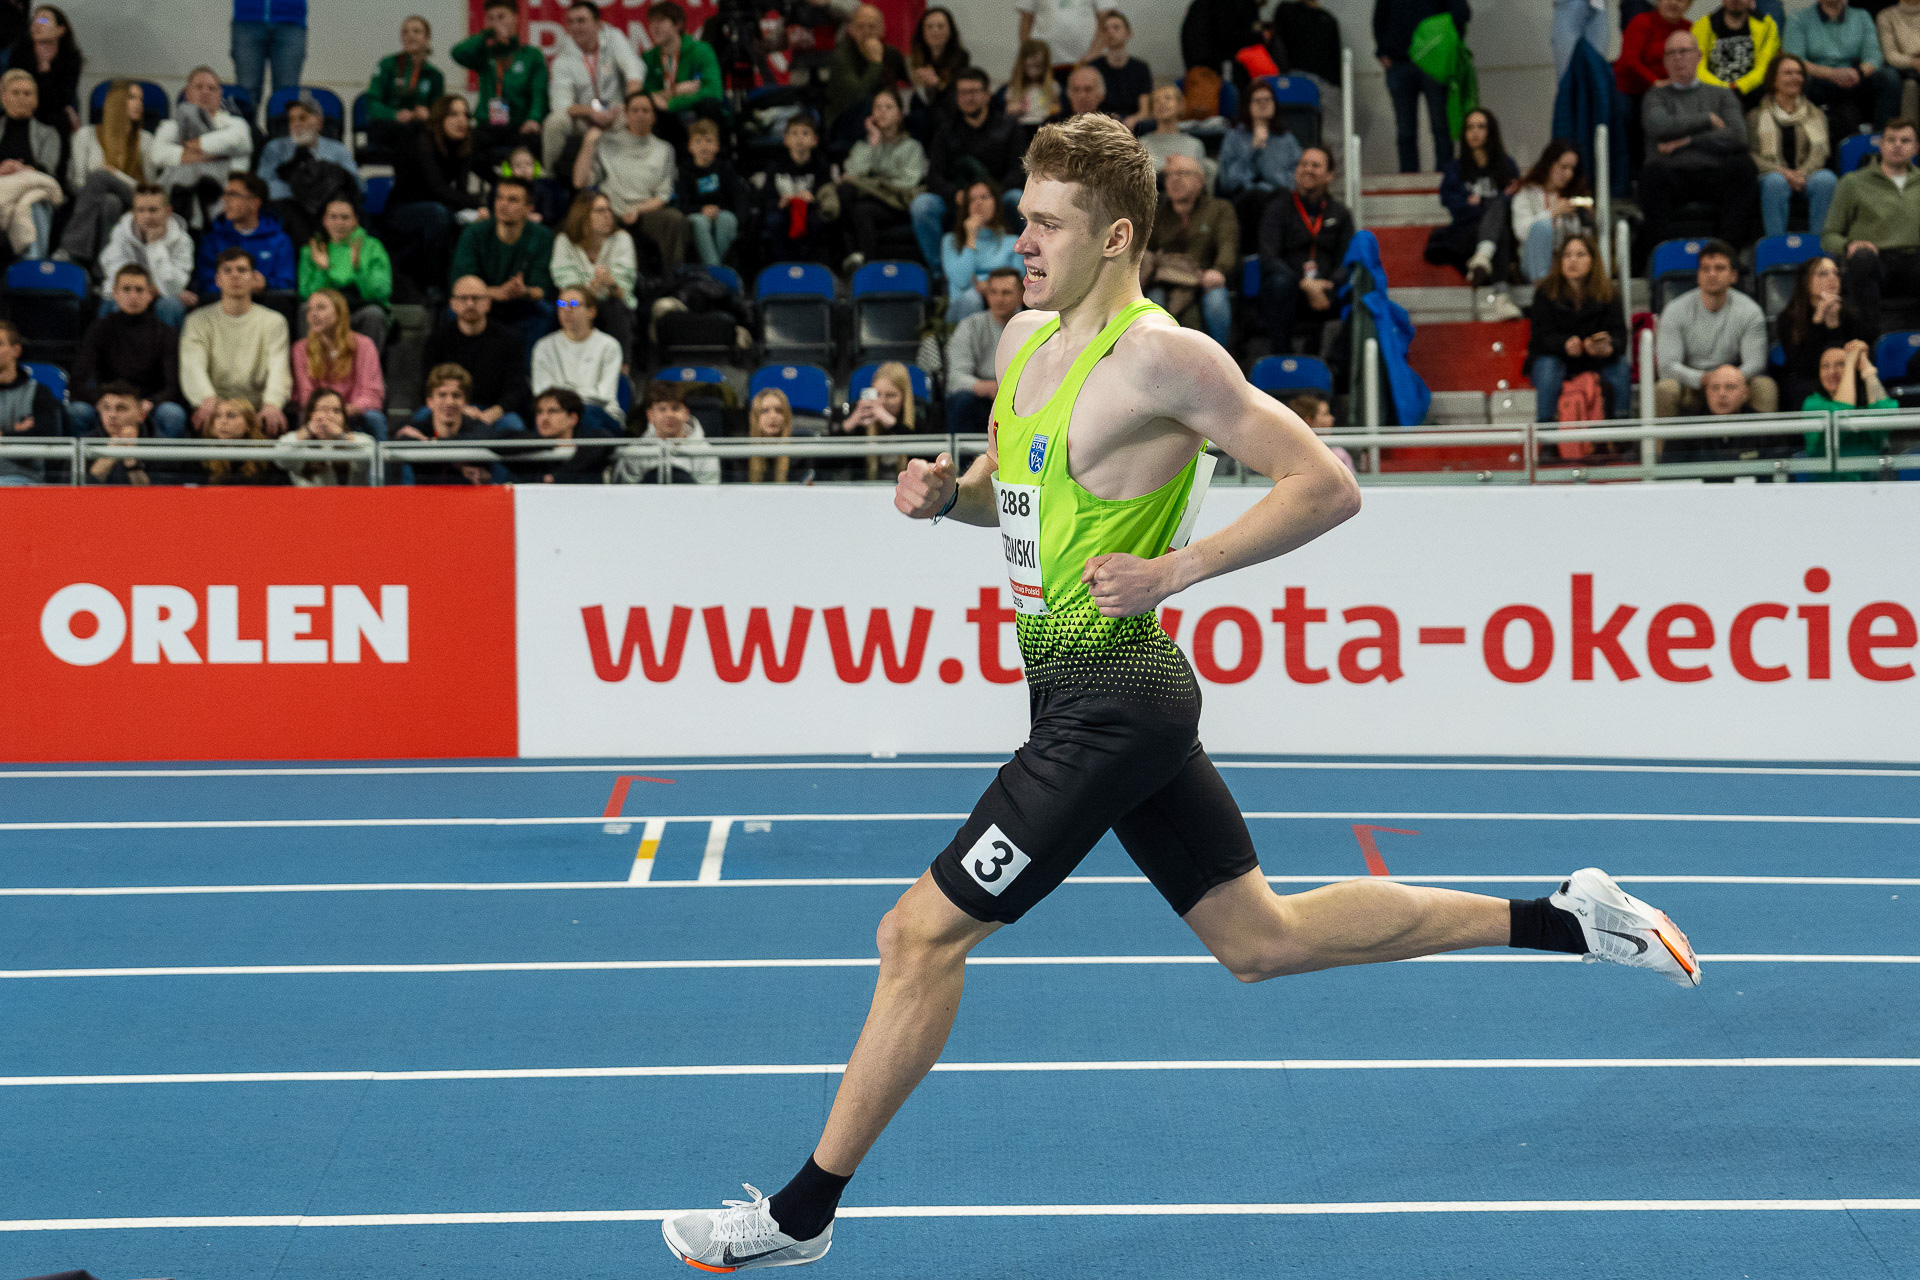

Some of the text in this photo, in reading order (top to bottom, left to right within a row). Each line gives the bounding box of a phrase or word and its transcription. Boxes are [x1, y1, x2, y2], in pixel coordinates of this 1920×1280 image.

[1000, 488, 1031, 517] 288
[1001, 532, 1036, 569] ZEWSKI
[41, 583, 408, 666] ORLEN
[581, 567, 1918, 684] www.tota-okecie
[974, 840, 1014, 883] 3
